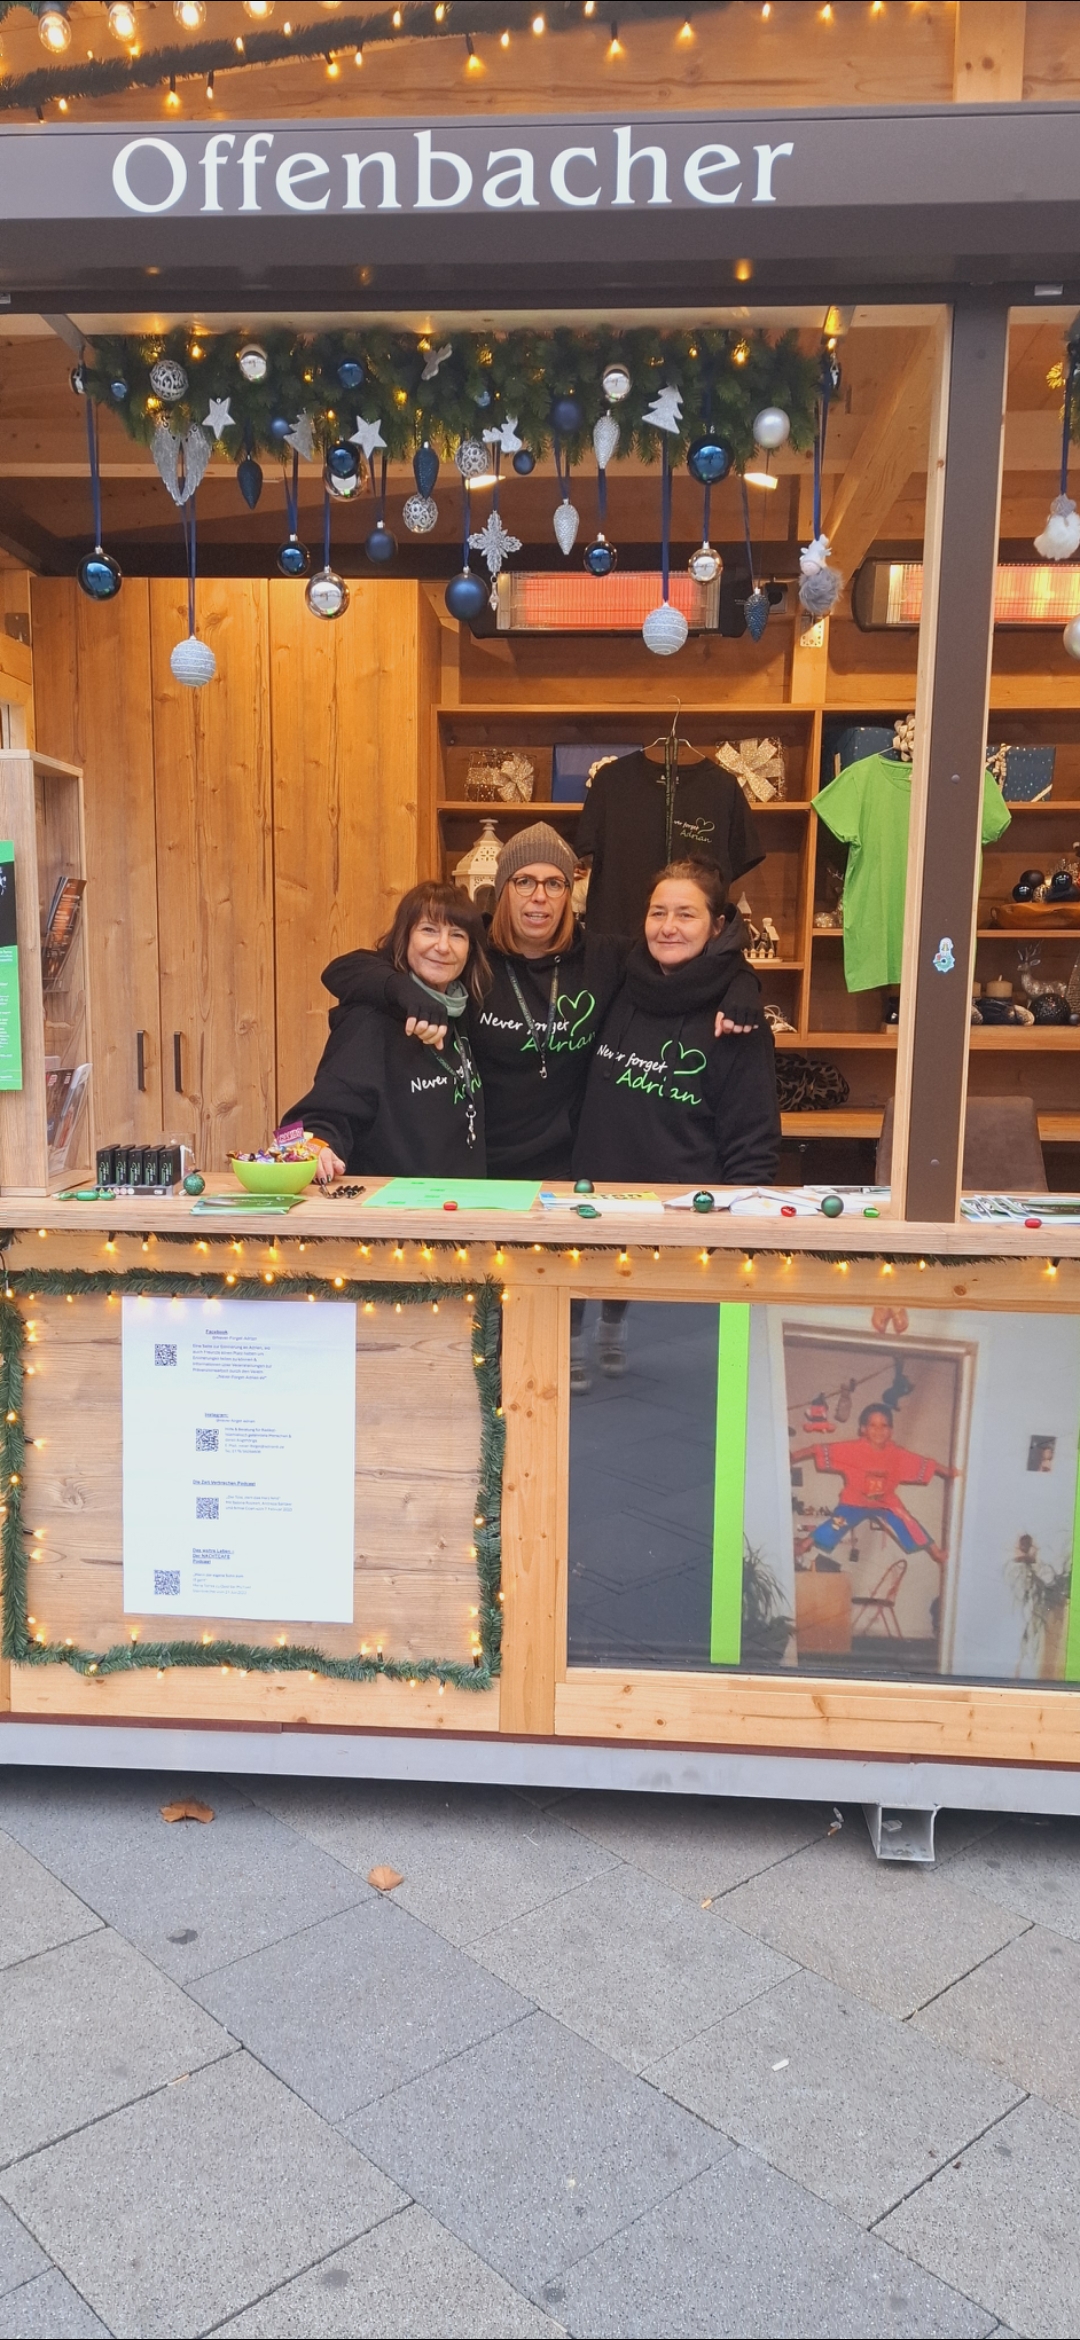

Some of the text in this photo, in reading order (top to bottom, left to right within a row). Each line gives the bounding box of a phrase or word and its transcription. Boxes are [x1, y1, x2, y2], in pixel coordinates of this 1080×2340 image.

[112, 126, 795, 213] Offenbacher
[479, 1012, 524, 1031] Never
[624, 1052, 669, 1074] forget
[410, 1075, 448, 1094] Never
[615, 1067, 703, 1106] Adrian
